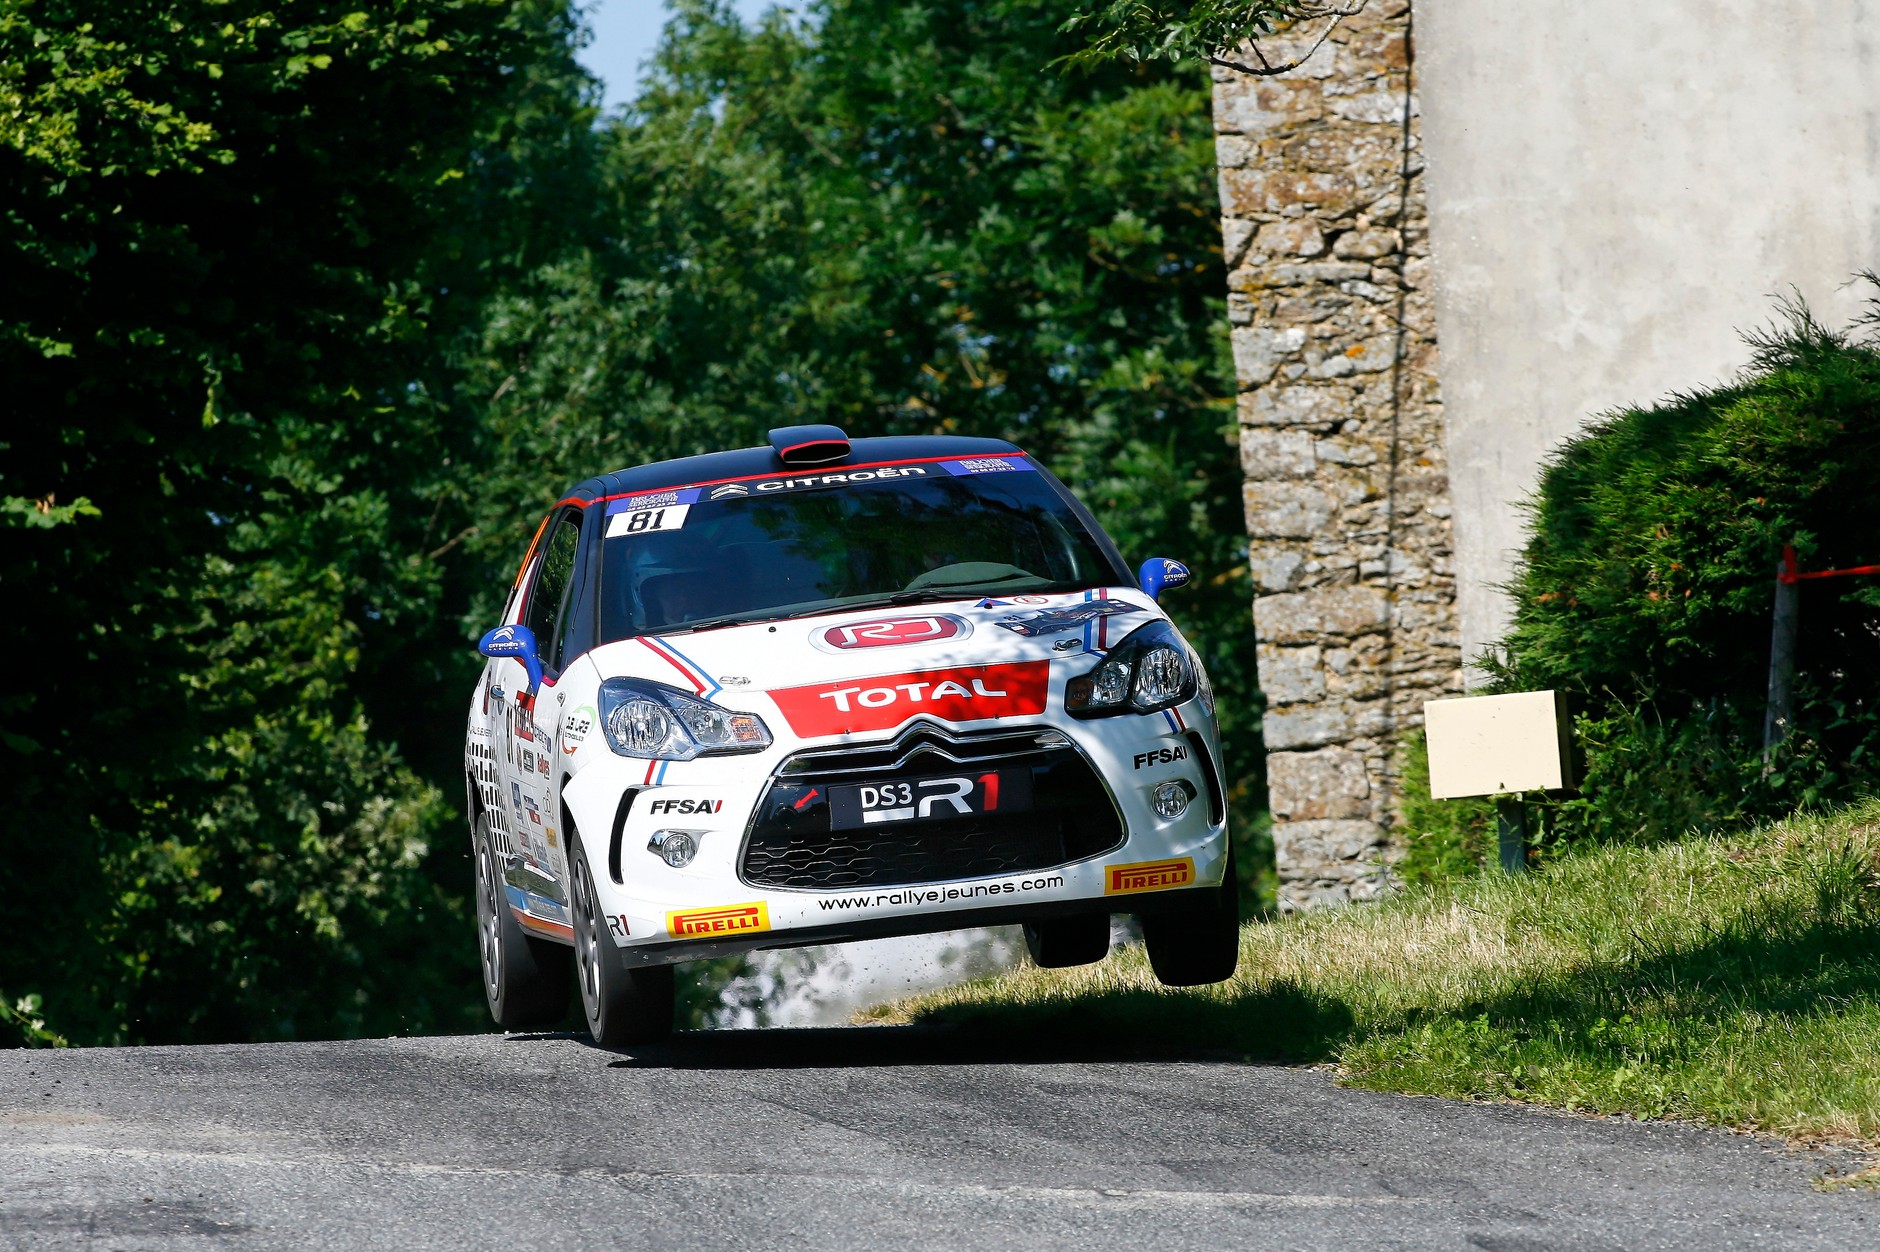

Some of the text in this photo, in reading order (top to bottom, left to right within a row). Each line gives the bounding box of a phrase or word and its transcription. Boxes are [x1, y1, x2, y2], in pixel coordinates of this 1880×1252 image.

[627, 508, 666, 533] 81
[840, 617, 943, 647] RJ
[819, 678, 1007, 712] TOTAL
[1133, 747, 1186, 770] FFSA
[650, 800, 715, 815] FFSA
[860, 773, 1000, 818] DS3 R1
[1112, 862, 1188, 890] PIRELLI
[818, 876, 1064, 910] www.rallyejeunes.com
[606, 914, 631, 936] R1
[673, 906, 760, 935] PIRELLI
